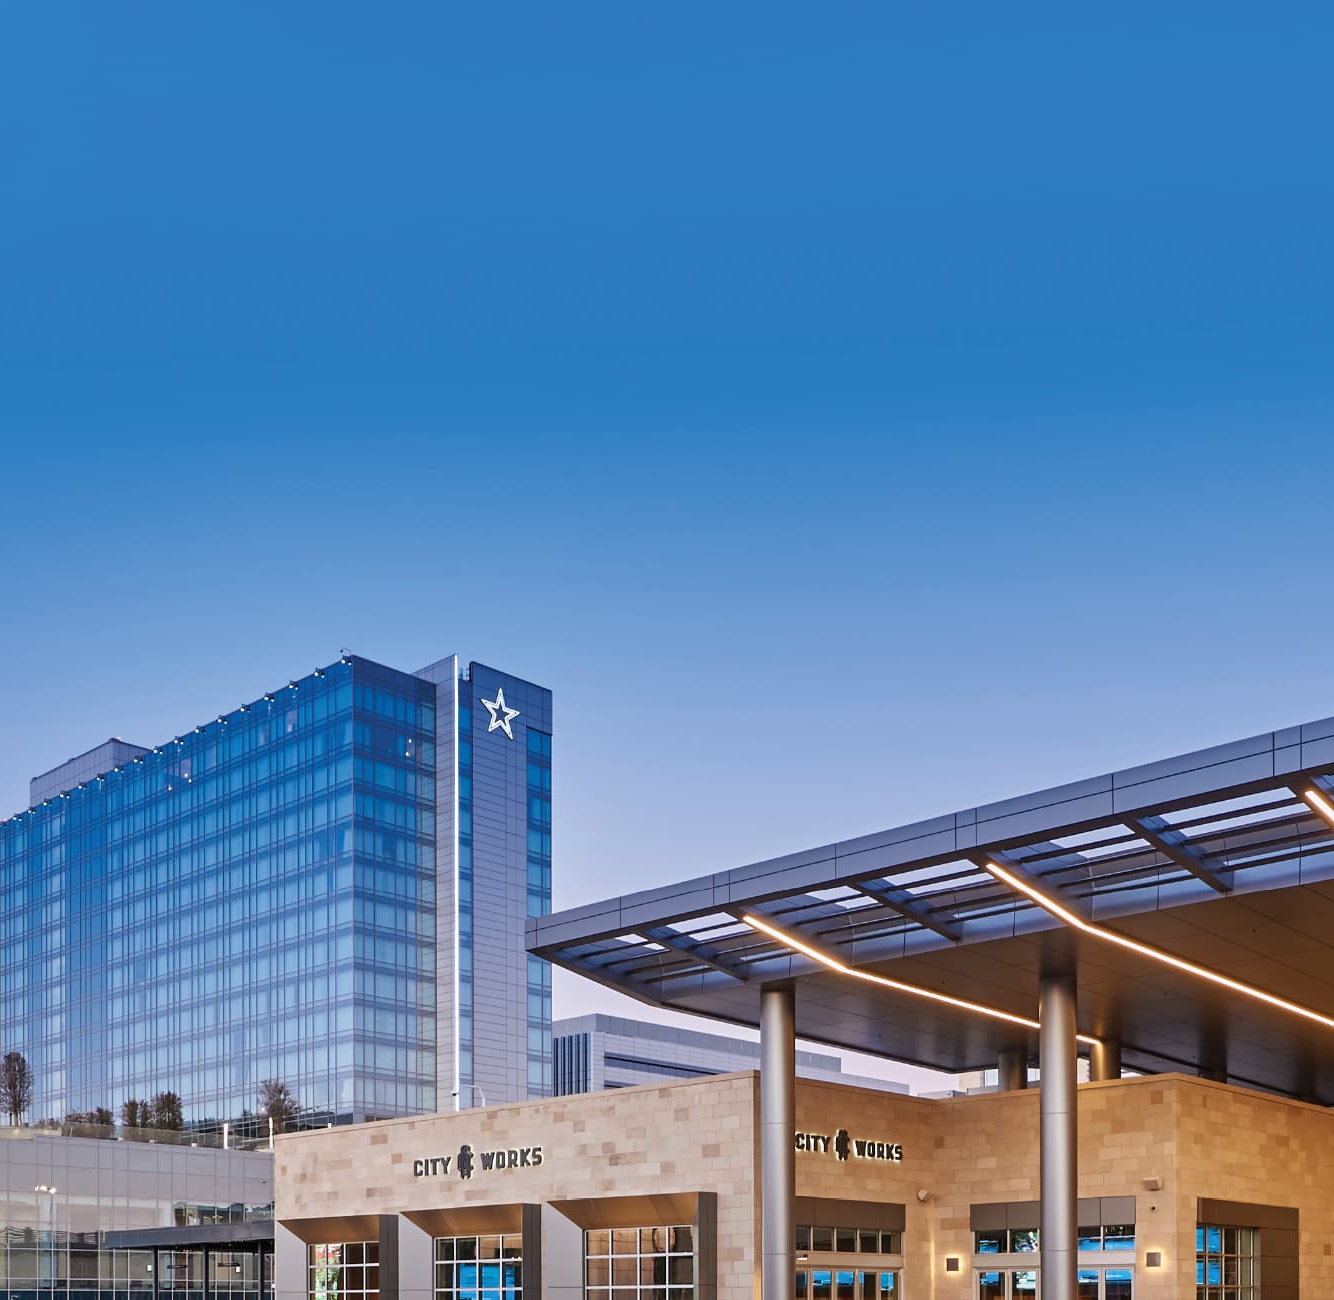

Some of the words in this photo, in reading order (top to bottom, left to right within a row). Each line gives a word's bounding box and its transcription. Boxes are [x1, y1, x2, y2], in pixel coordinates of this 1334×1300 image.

[794, 1133, 831, 1152] CITY
[854, 1140, 903, 1160] WORKS
[413, 1156, 452, 1177] CITY
[480, 1147, 543, 1171] WORKS
